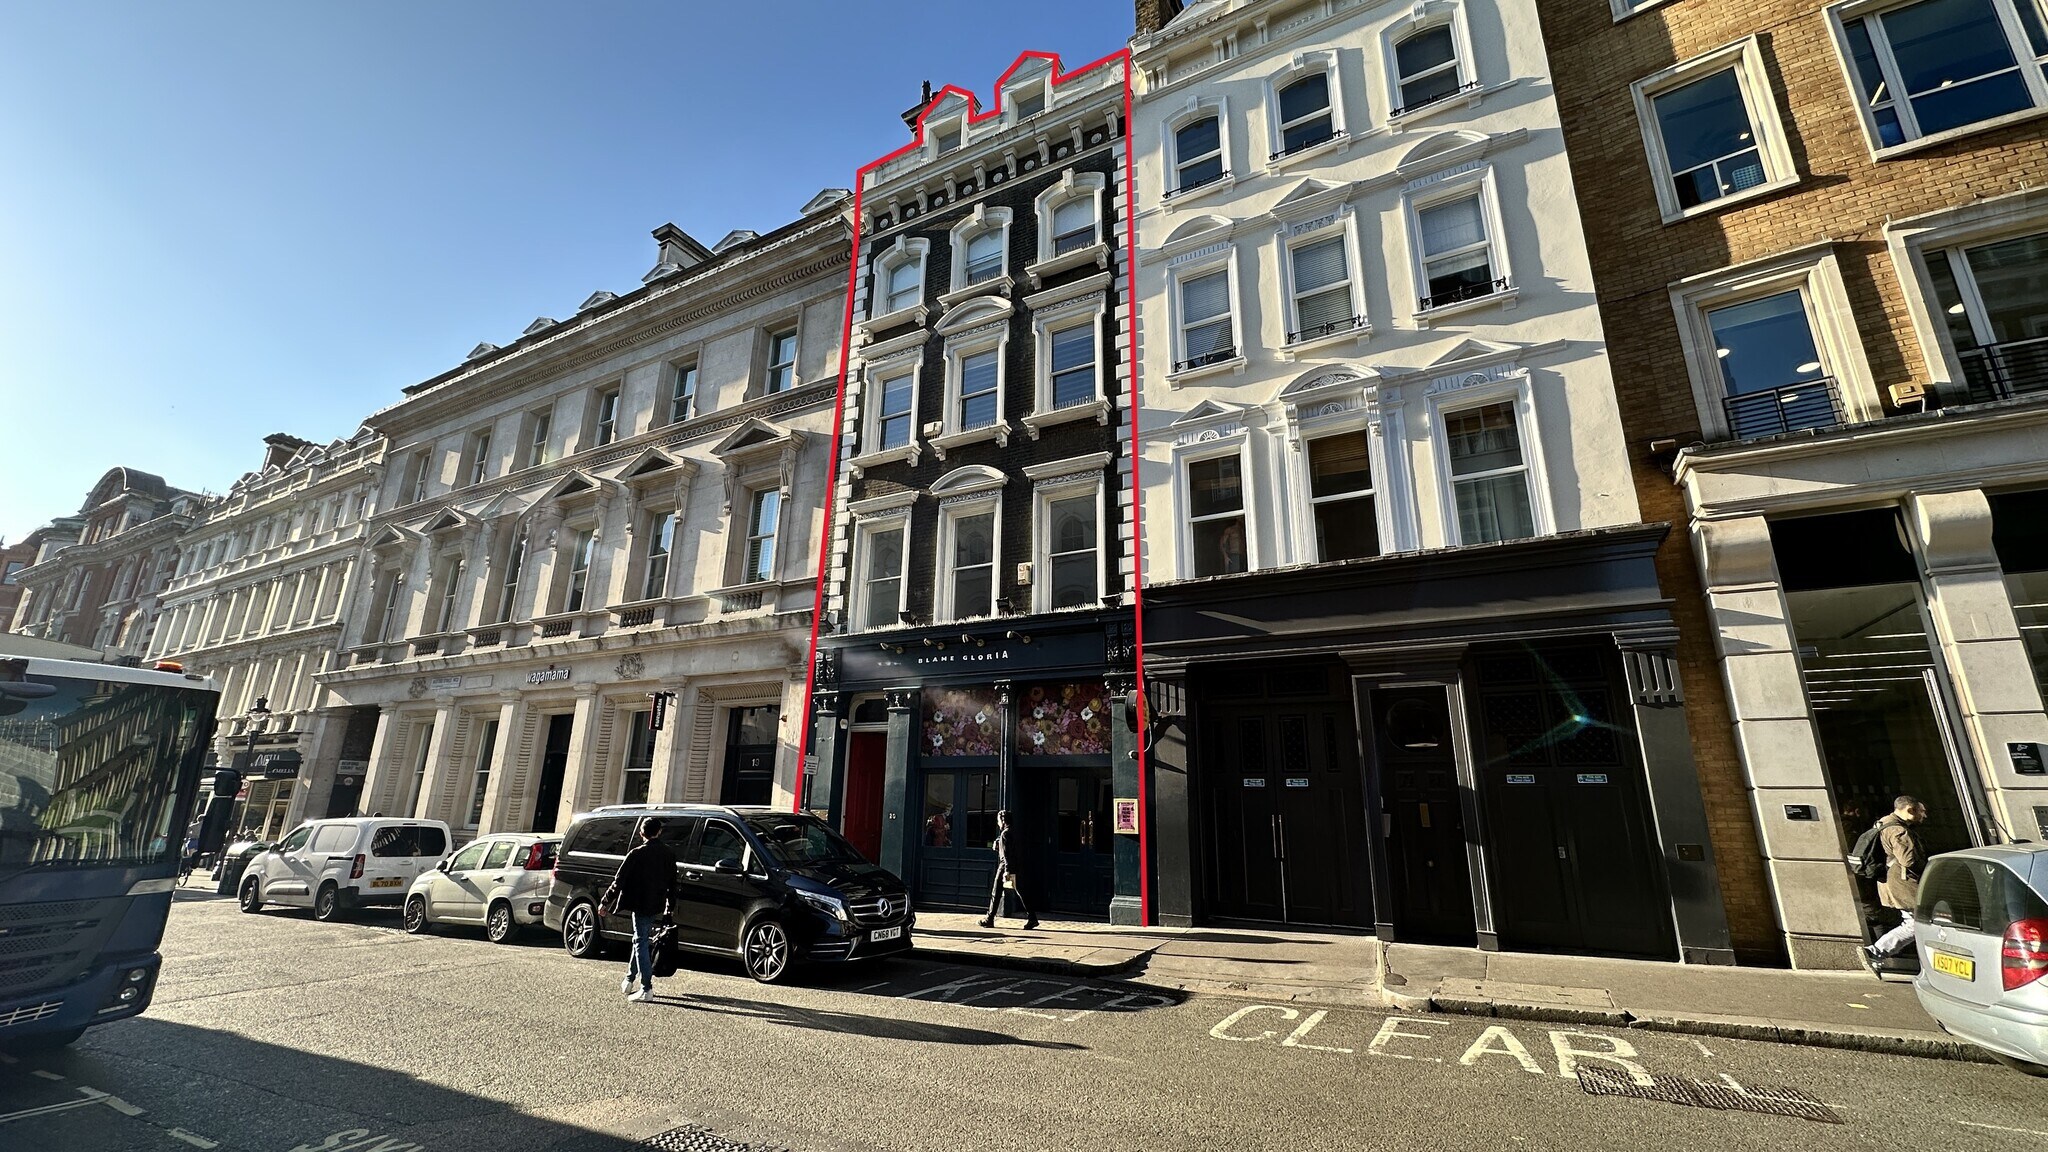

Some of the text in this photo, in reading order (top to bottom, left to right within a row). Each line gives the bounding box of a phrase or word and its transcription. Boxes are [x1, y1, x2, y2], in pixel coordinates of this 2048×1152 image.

[917, 650, 1009, 664] BLAME GLORIA
[525, 668, 569, 685] wagamama
[1209, 1005, 1656, 1087] CLEAR
